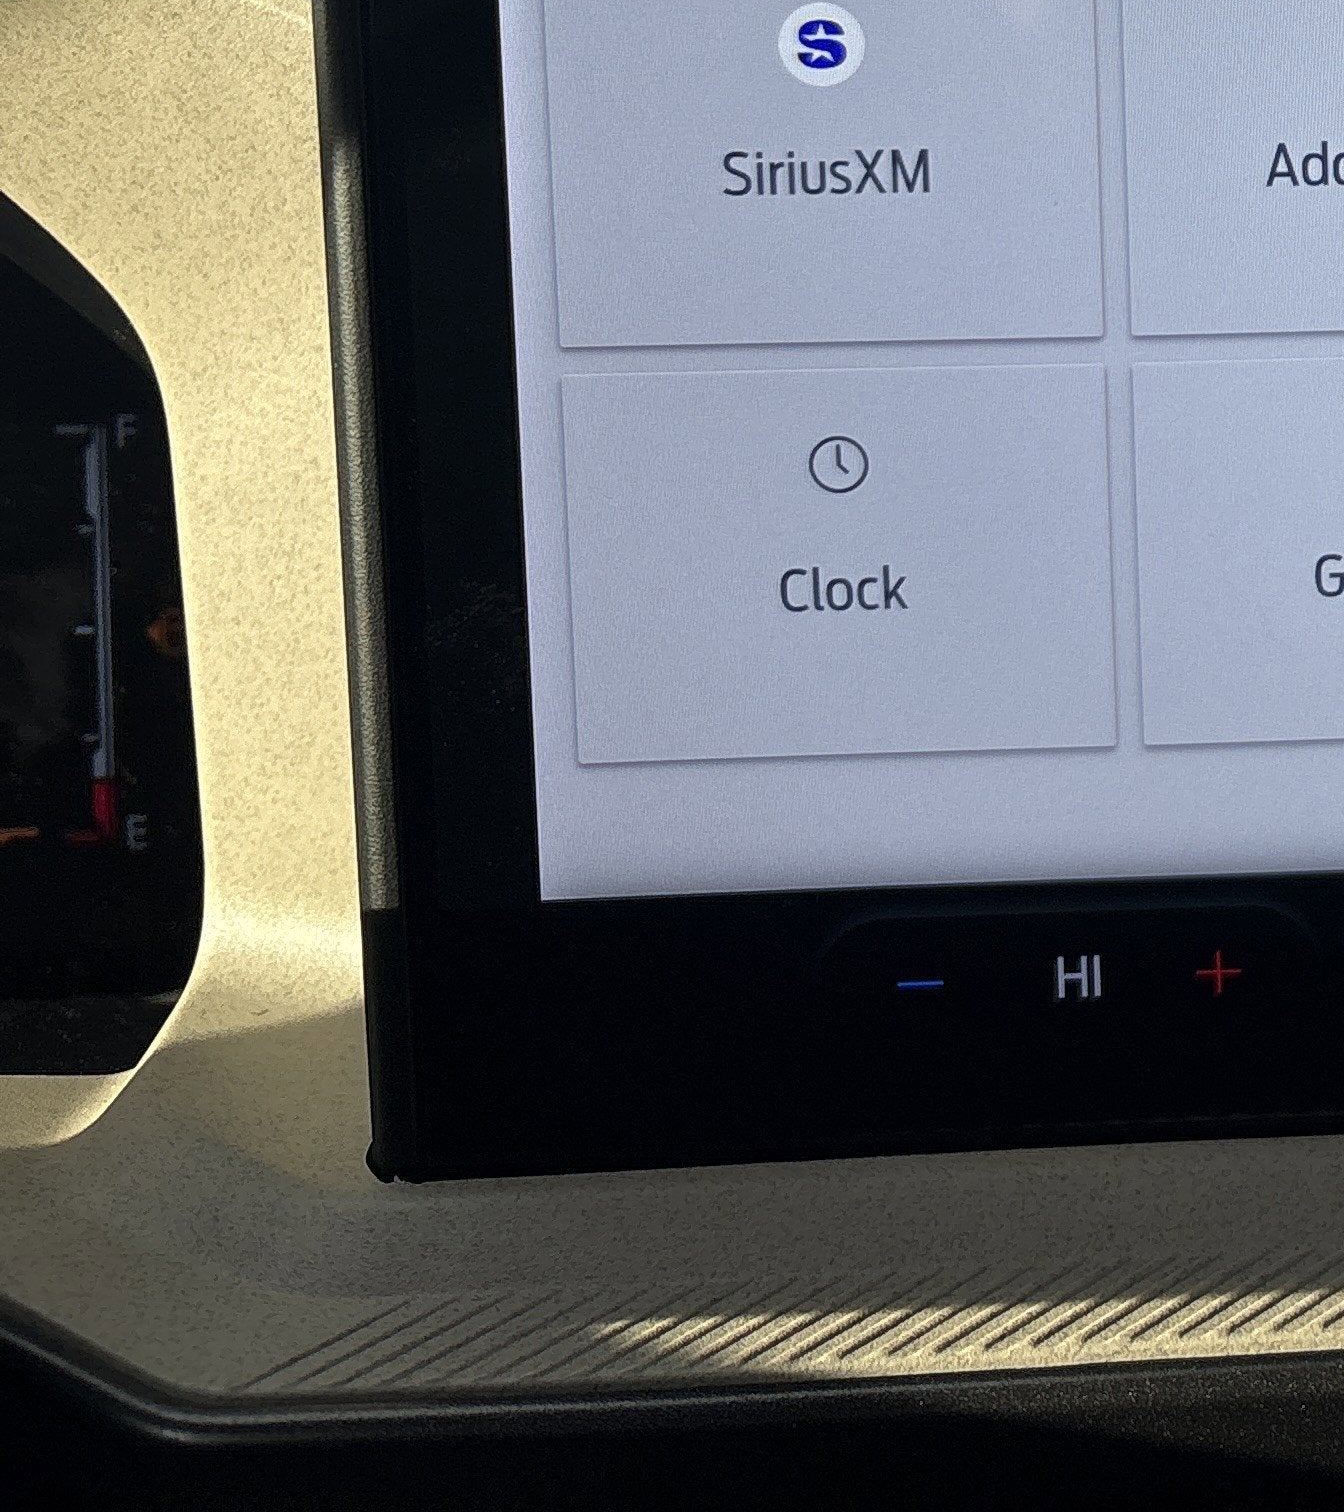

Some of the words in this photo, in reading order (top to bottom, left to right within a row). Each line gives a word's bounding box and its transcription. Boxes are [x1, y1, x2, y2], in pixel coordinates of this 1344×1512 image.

[722, 148, 930, 197] SiriusXM
[779, 564, 908, 613] Clock
[126, 814, 147, 850] E
[1056, 954, 1102, 999] HI
